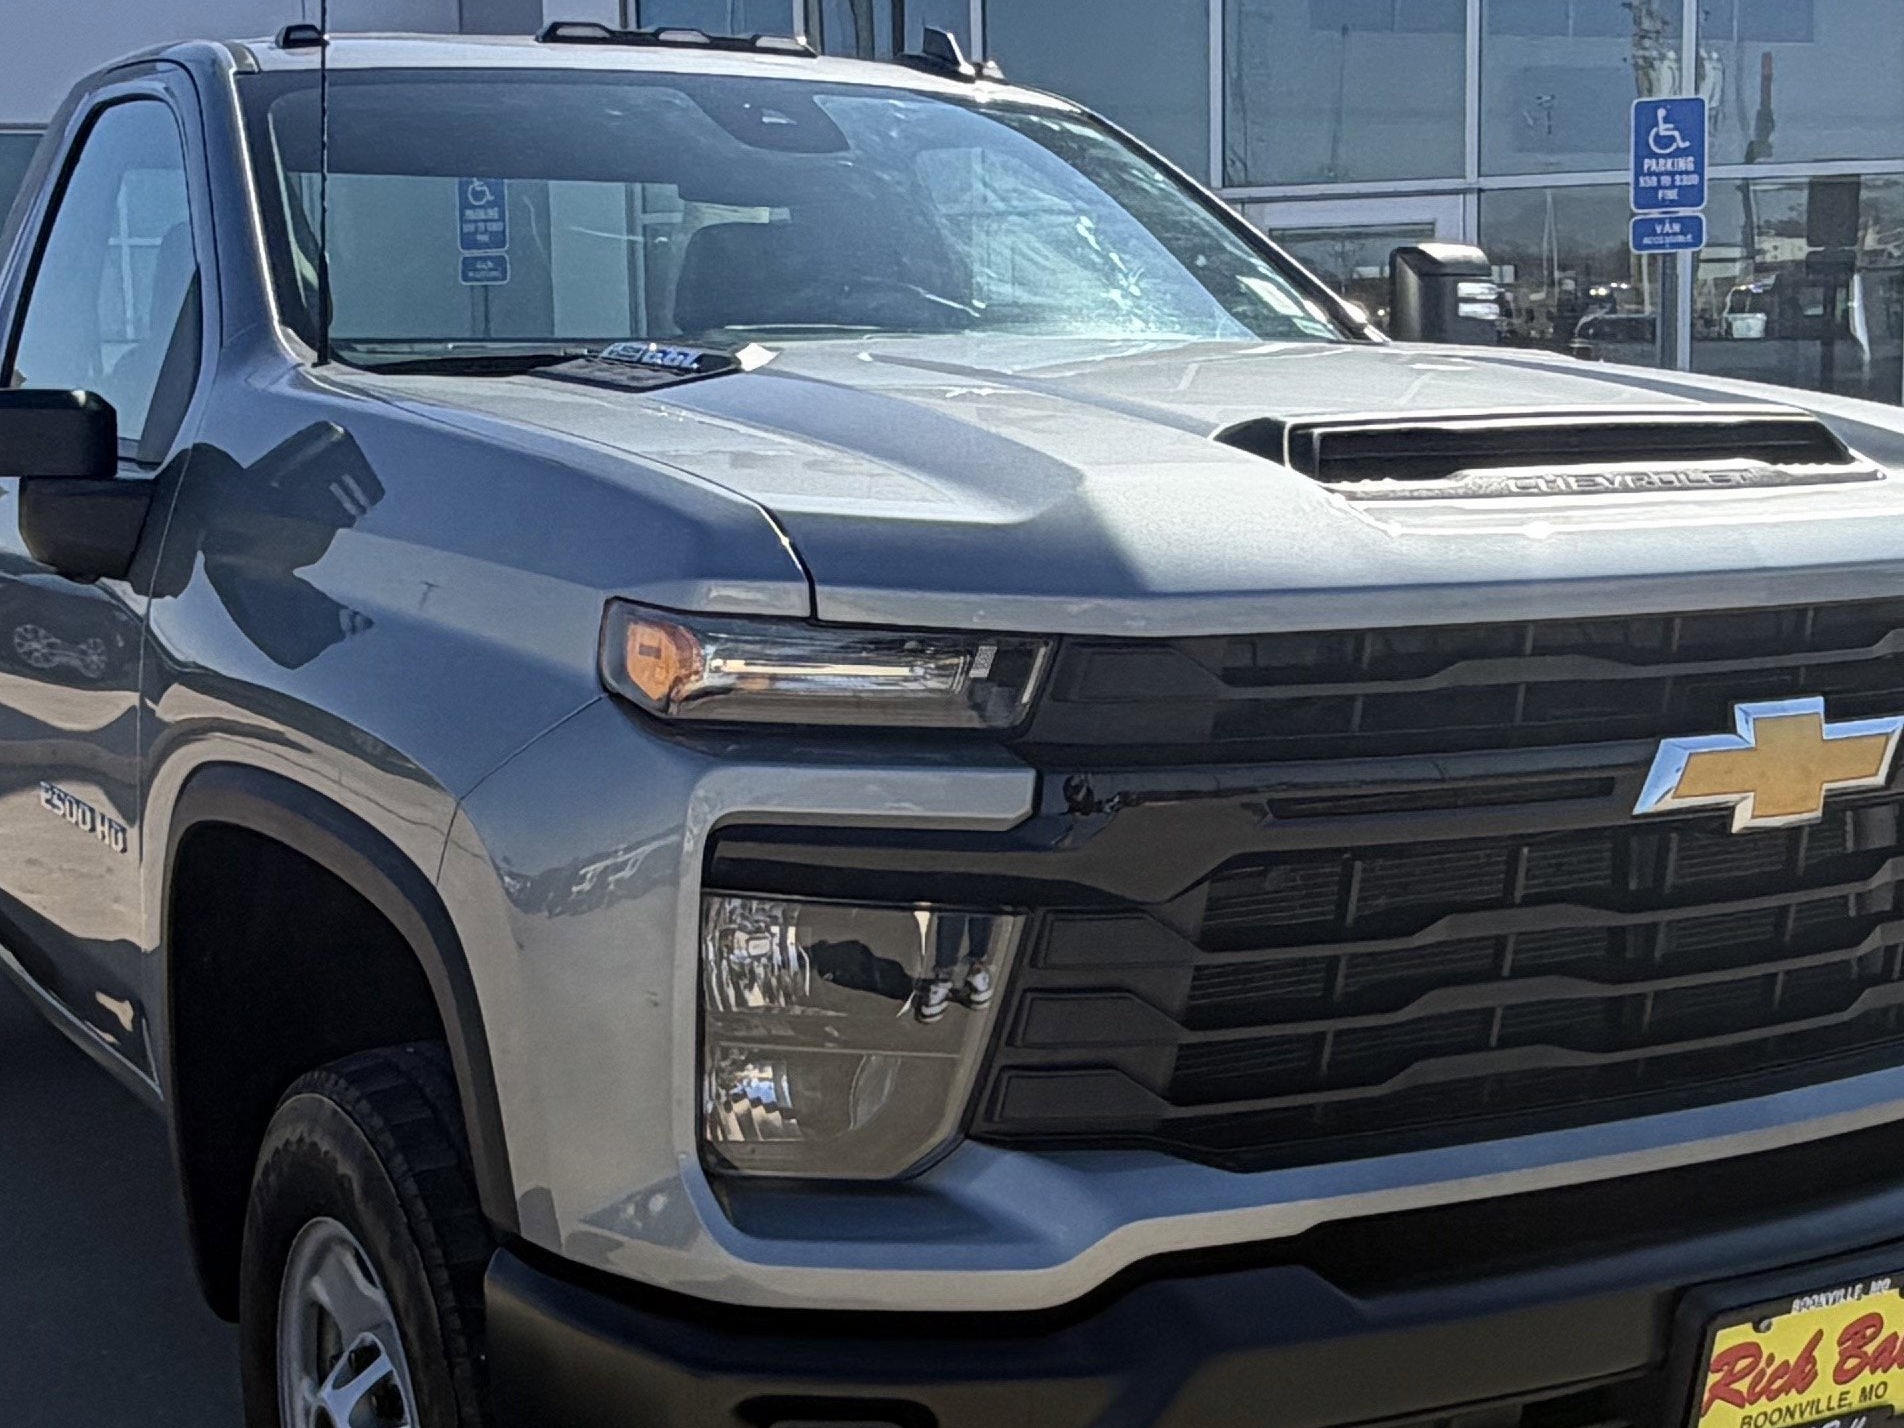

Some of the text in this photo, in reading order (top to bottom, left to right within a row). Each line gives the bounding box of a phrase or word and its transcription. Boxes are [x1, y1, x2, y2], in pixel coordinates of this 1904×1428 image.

[1643, 156, 1695, 174] PARKING
[1654, 222, 1682, 234] VAN
[1505, 468, 1755, 493] CHEVROLET
[40, 781, 127, 853] 2500 HD
[1701, 1329, 1824, 1418] Rick
[1859, 1381, 1889, 1403] MO
